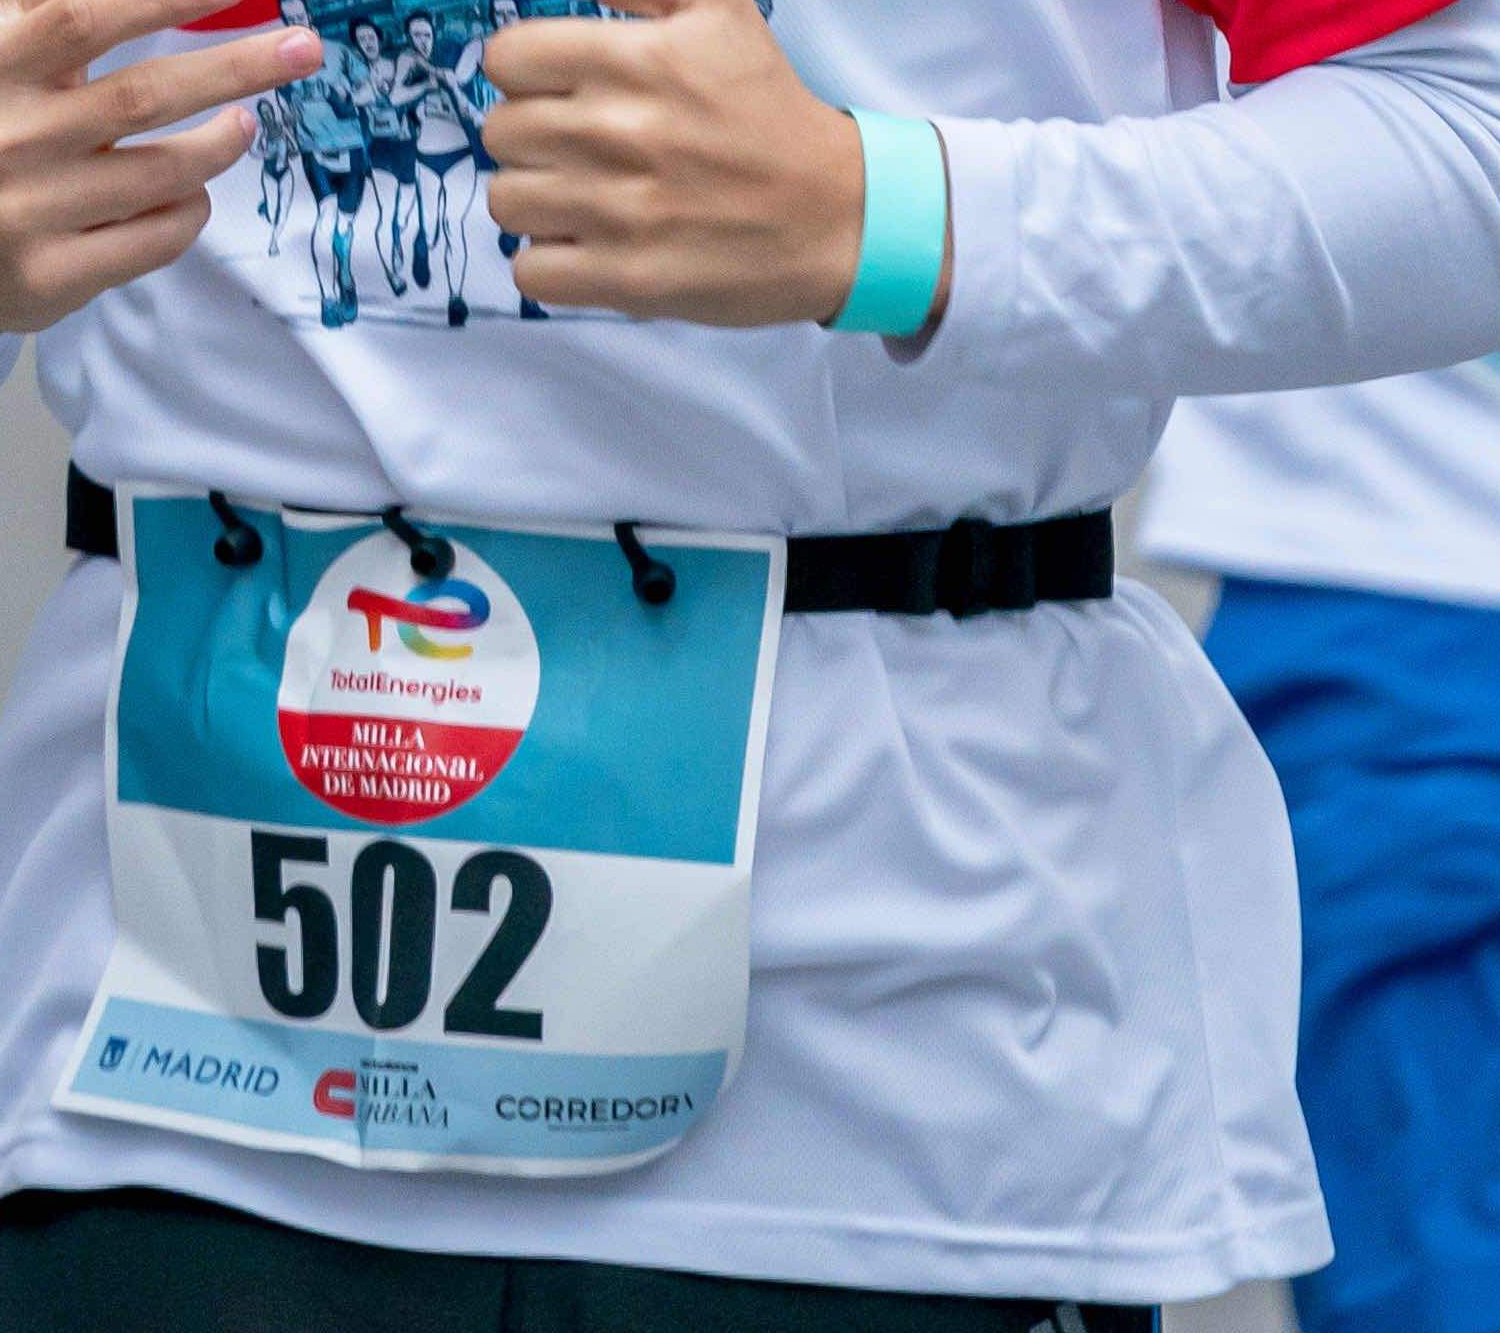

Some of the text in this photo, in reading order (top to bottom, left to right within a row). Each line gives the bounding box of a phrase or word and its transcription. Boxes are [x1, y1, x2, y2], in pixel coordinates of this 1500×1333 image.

[332, 668, 482, 705] TotalEnergies
[352, 721, 425, 750] MILLA
[323, 772, 452, 804] DE MADRID
[250, 829, 554, 1041] 502
[142, 1044, 280, 1097] MADRID
